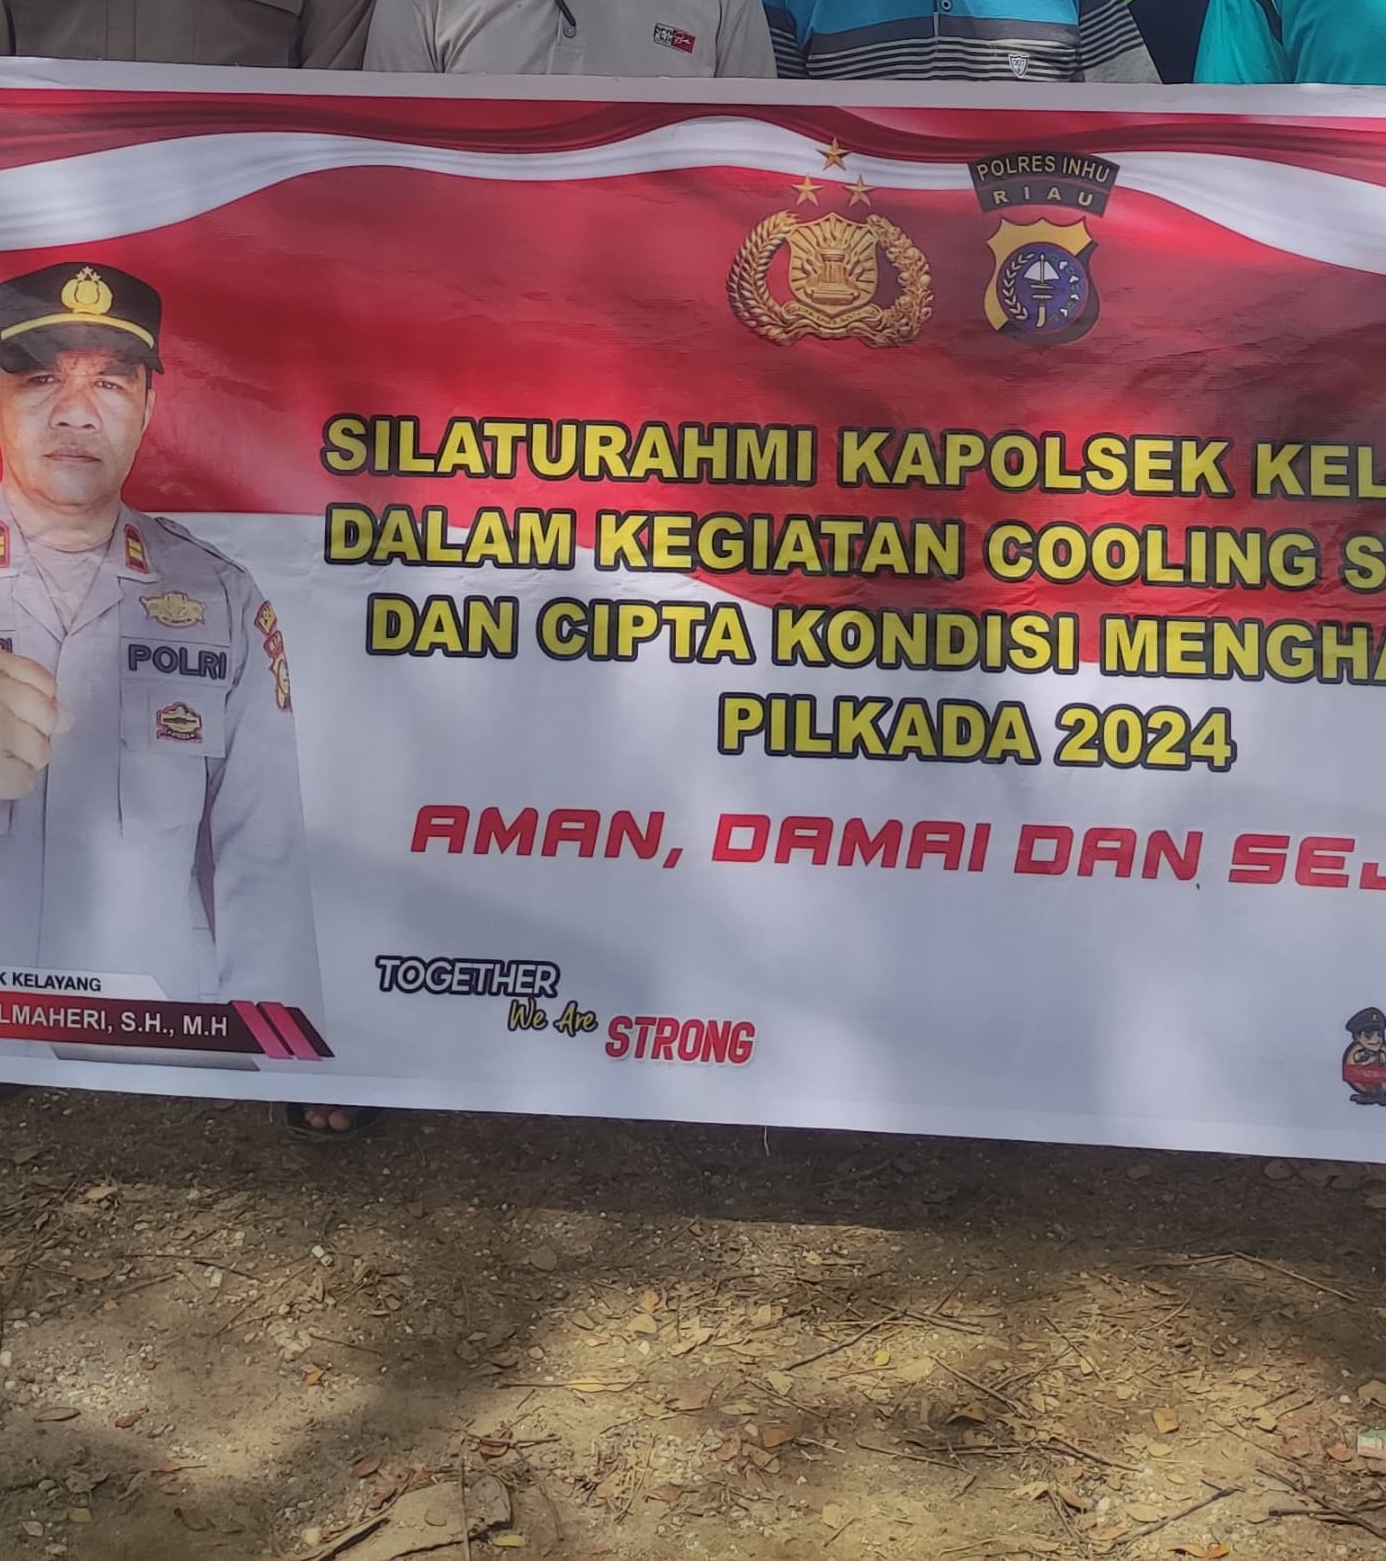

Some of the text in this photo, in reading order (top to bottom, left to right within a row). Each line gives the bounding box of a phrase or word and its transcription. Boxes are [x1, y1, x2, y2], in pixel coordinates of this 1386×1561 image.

[976, 155, 1111, 184] POLRES INHU
[321, 415, 815, 487] SILATURAHMI
[839, 427, 1235, 498] KAPOLSEK
[325, 503, 577, 571] DALAM
[595, 508, 964, 579] KEGIATAN
[984, 522, 1318, 590] COOLING
[367, 592, 518, 660] DAN
[537, 596, 756, 664] CIPTA
[772, 605, 1079, 675] KONDISI
[128, 644, 228, 680] POLRI
[718, 692, 1237, 773] PILKADA 2024
[410, 804, 684, 869] AMAN,
[711, 813, 992, 872] DAMAI
[1013, 824, 1204, 881] DAN
[12, 972, 102, 993] KELAYANG
[376, 955, 560, 998] TOGETHER
[120, 1012, 174, 1038] S.H.,
[182, 1014, 228, 1037] M.H
[508, 998, 599, 1037] We Are
[605, 1015, 757, 1065] STRONG
